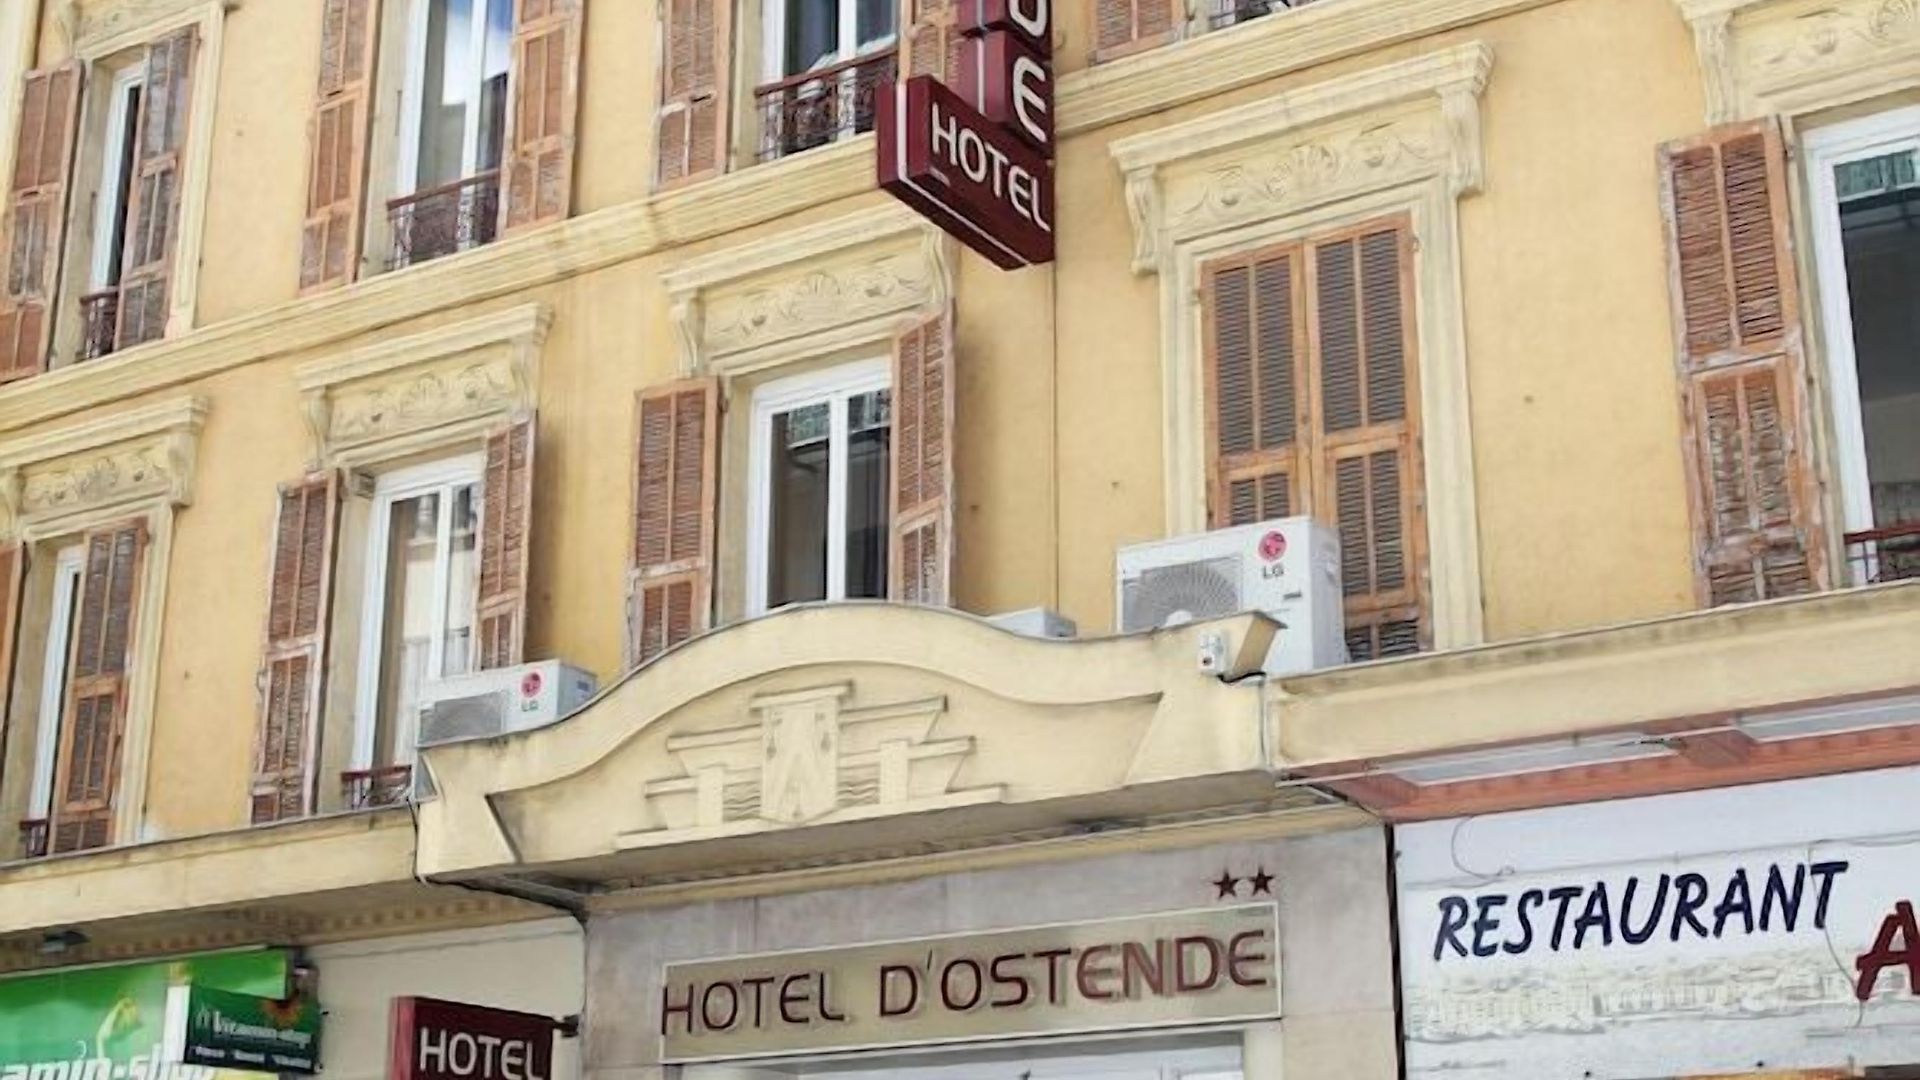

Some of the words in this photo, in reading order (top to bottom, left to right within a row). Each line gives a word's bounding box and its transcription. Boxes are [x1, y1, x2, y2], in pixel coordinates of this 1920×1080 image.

[931, 101, 1052, 232] HOTEL
[1262, 564, 1285, 579] LG
[1433, 860, 1849, 961] RESTAURANT
[660, 971, 846, 1036] HOTEL
[879, 928, 1269, 1018] D'OSTENDE
[419, 1026, 543, 1080] HOTEL
